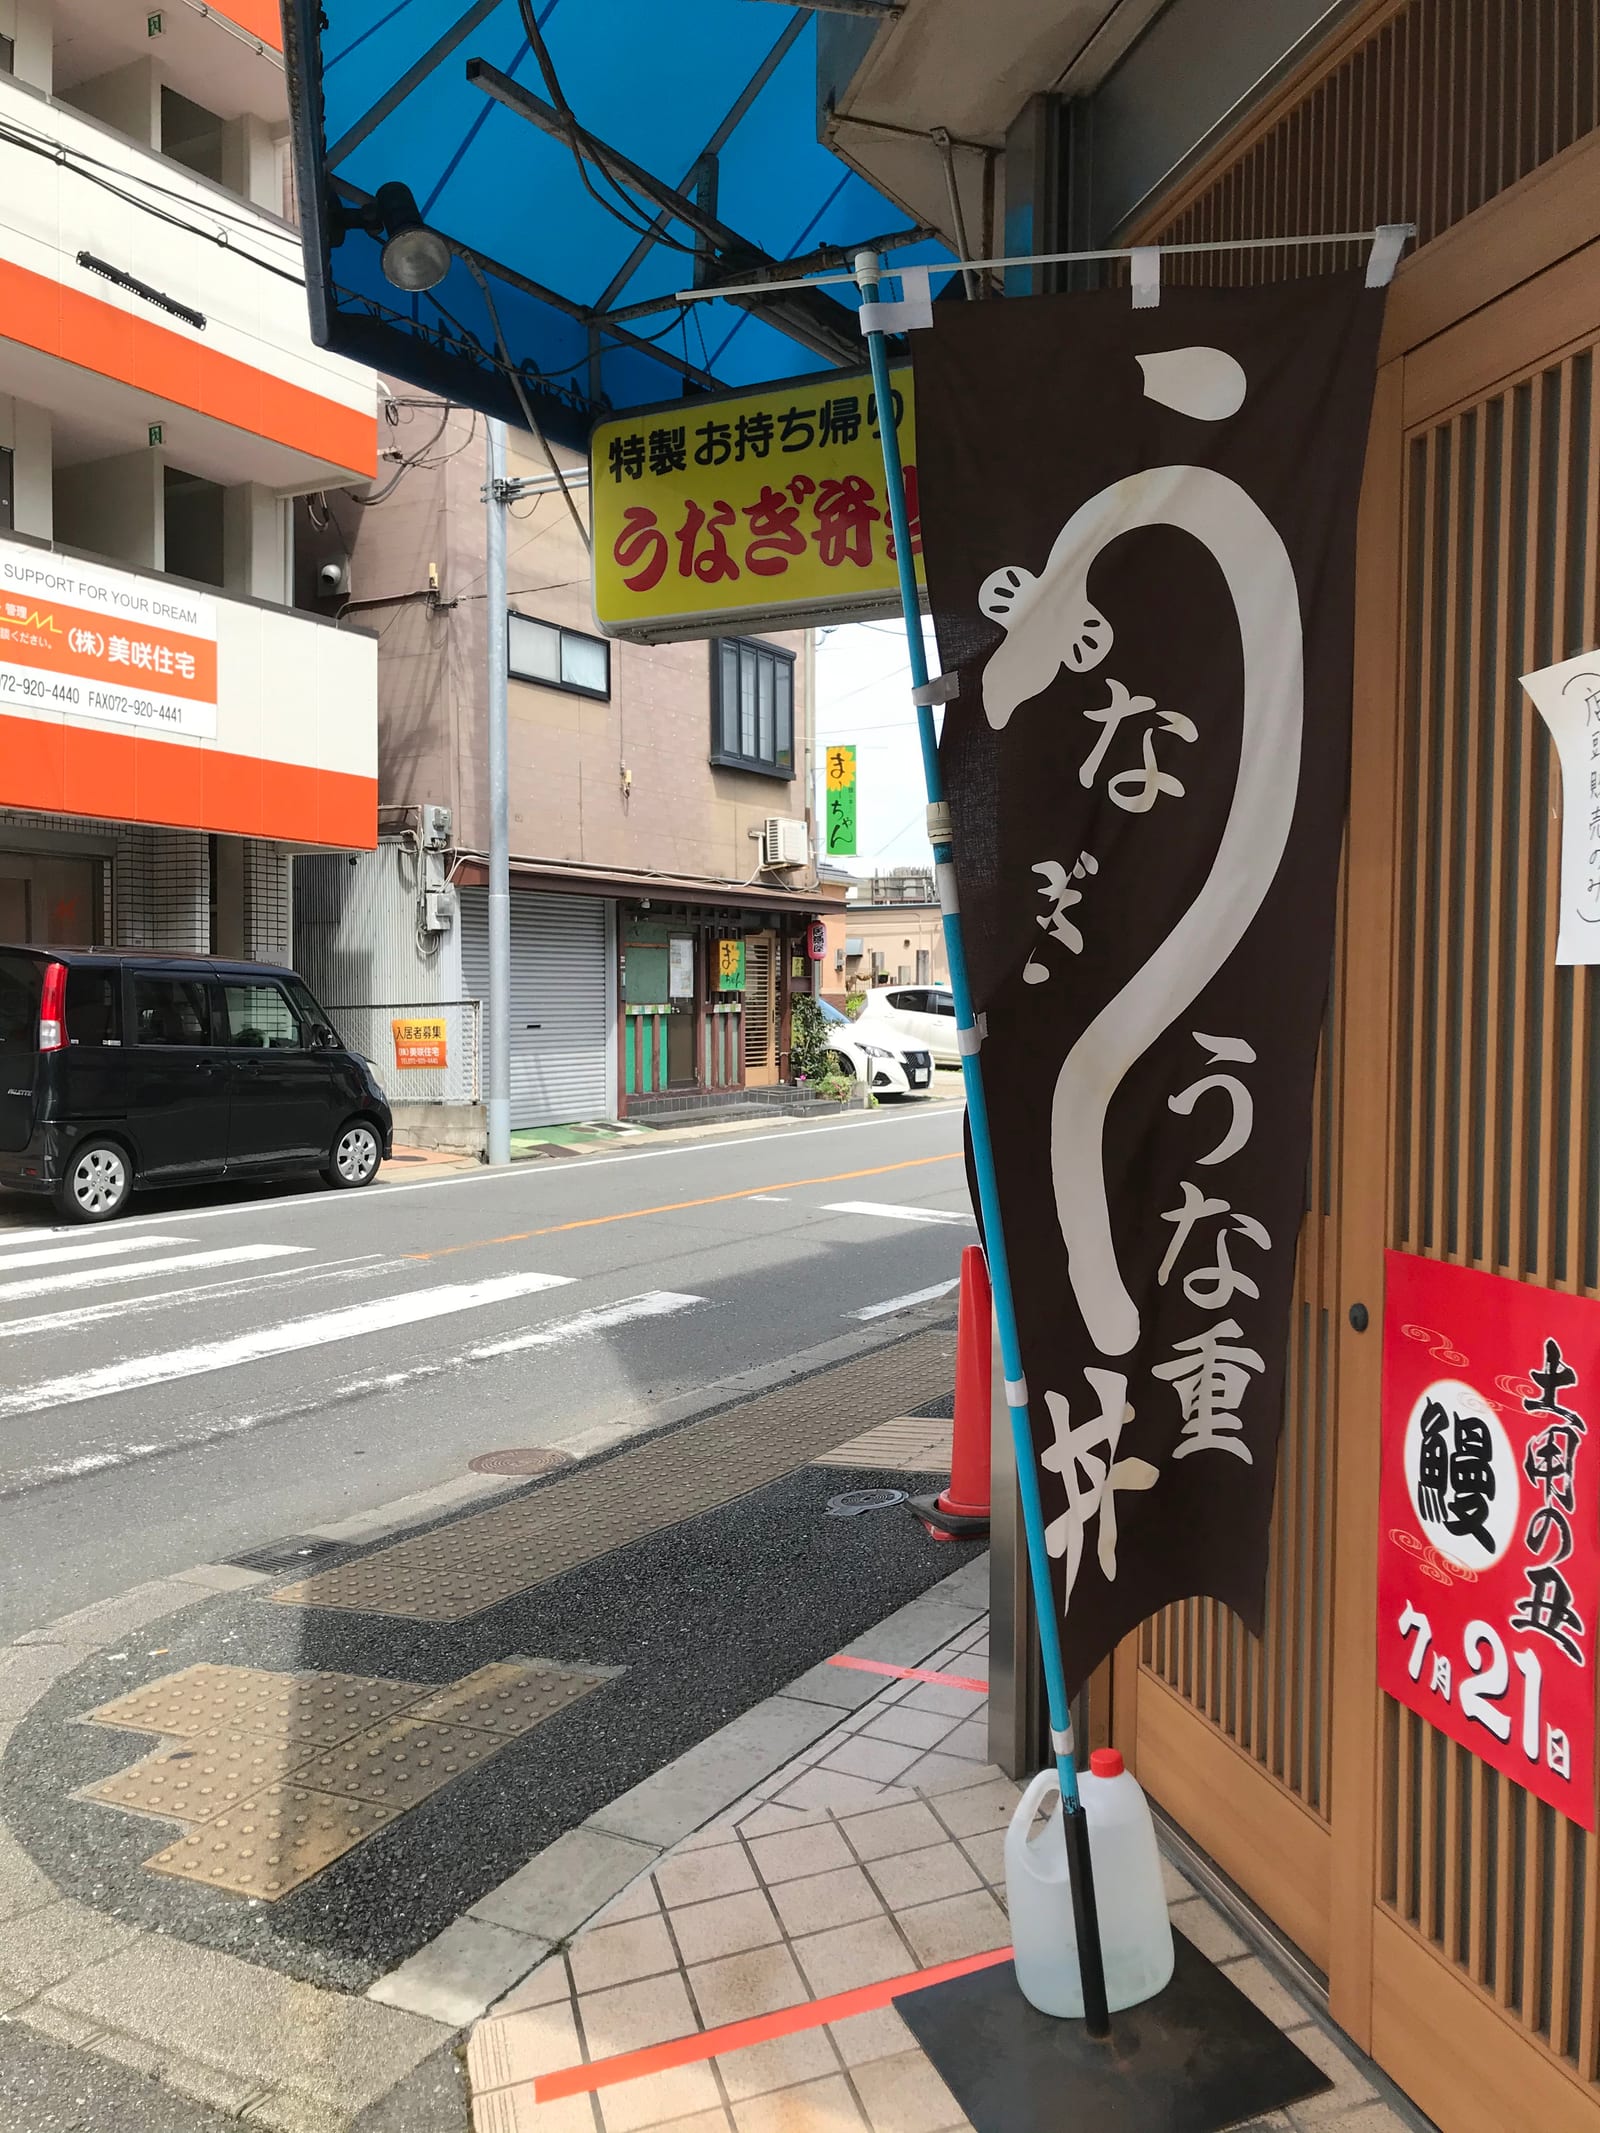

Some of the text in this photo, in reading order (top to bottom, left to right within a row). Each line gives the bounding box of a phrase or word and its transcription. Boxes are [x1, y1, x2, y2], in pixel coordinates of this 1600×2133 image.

[4, 564, 197, 624] SUPPORT FOR YOUR DREAM
[0, 673, 182, 724] 72-920-4440 FAX072-920-4441
[1152, 1031, 1272, 1466] うな重
[1417, 1396, 1497, 1555] 鰻
[1509, 1336, 1587, 1667] 土用の丑
[1398, 1599, 1572, 1783] 7月21日
